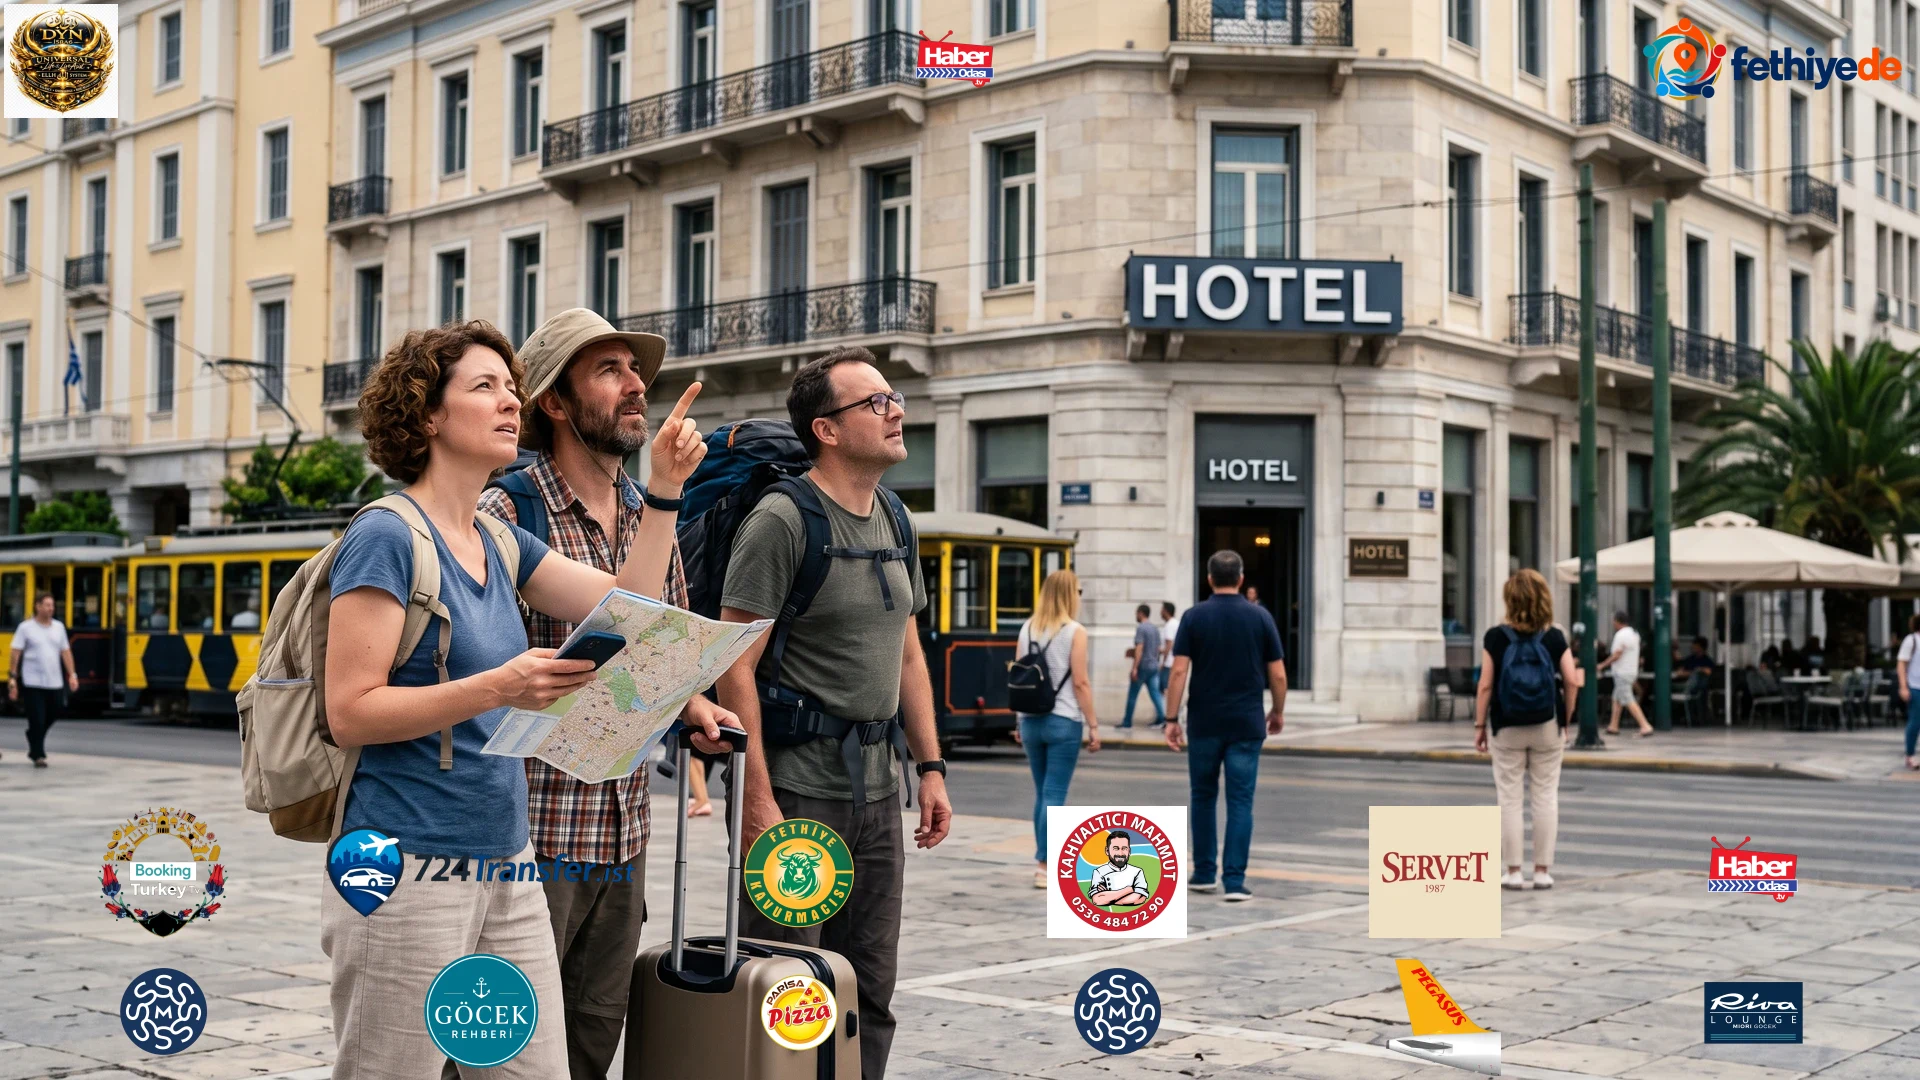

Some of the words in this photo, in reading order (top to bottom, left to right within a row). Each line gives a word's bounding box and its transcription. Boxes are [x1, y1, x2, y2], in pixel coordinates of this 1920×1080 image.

[1142, 263, 1392, 324] HOTEL
[1208, 458, 1298, 482] HOTEL
[1353, 544, 1405, 560] HOTEL
